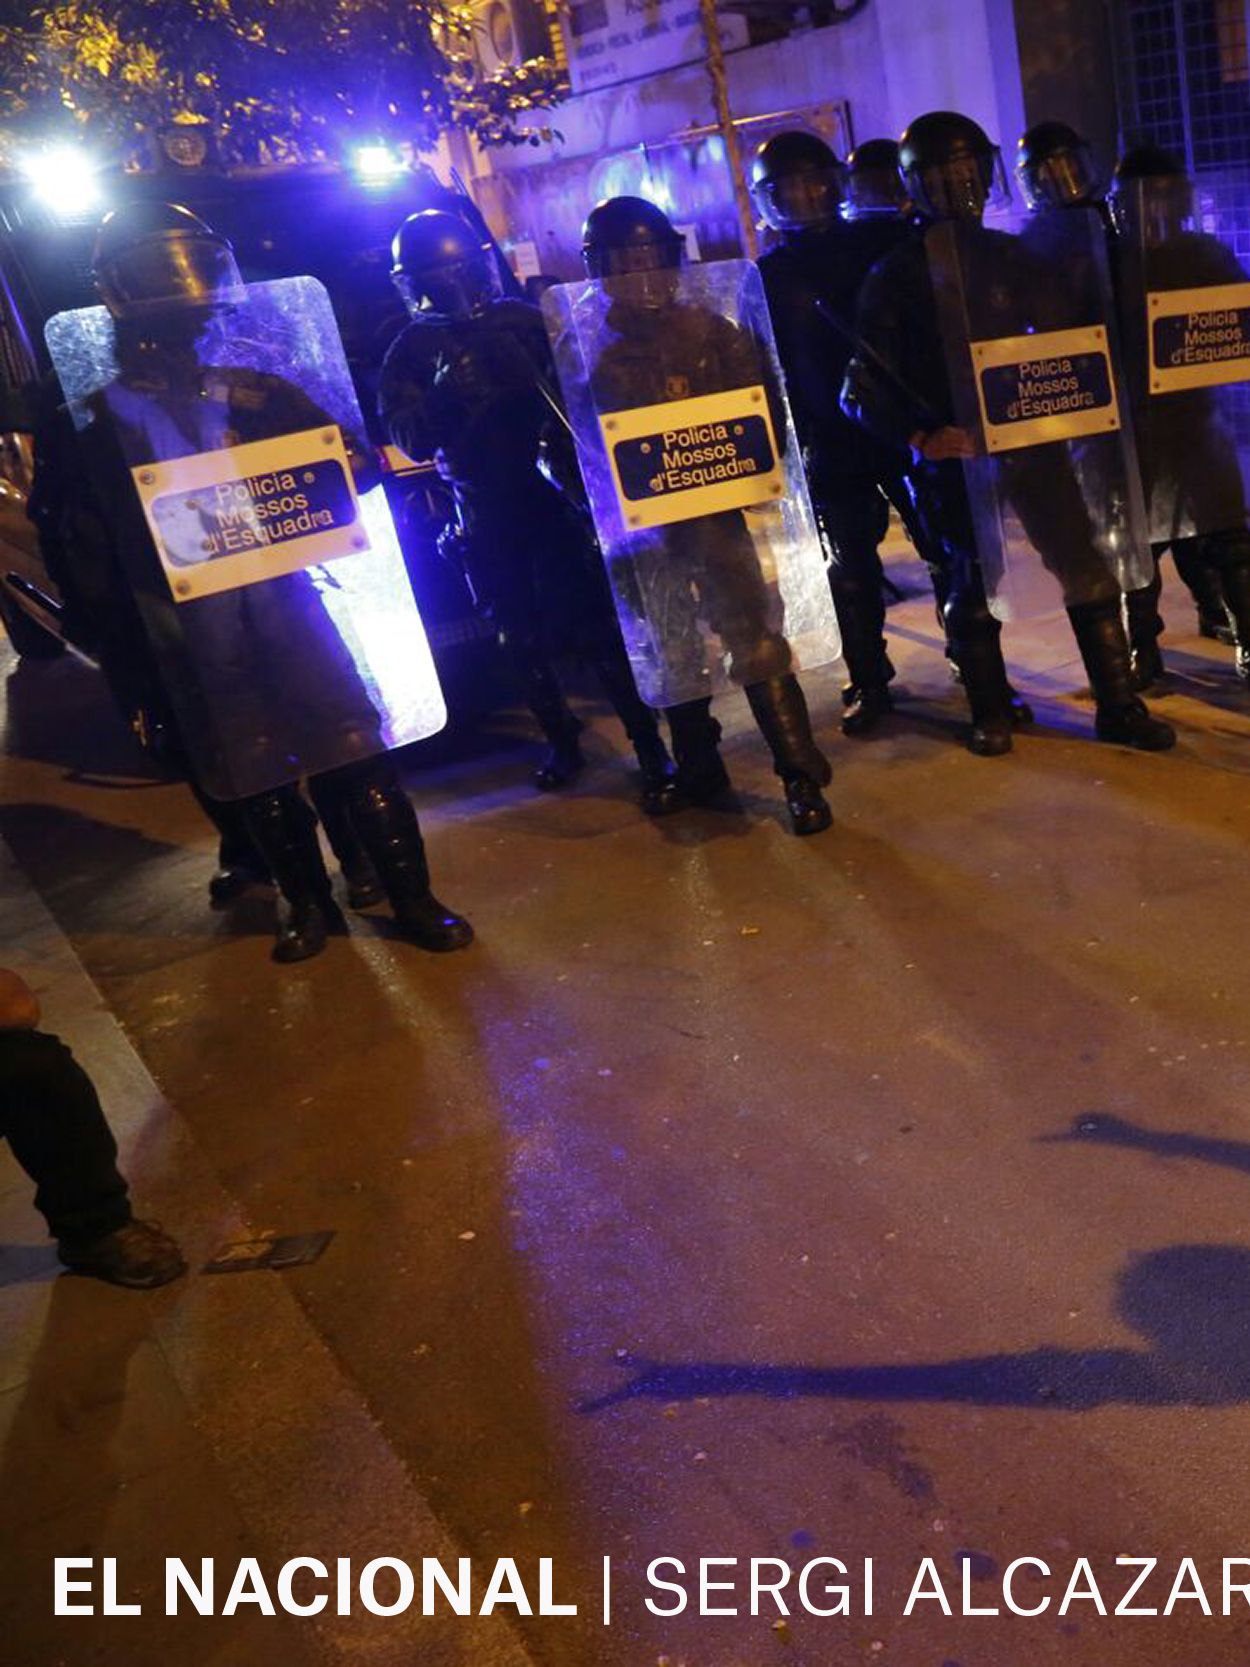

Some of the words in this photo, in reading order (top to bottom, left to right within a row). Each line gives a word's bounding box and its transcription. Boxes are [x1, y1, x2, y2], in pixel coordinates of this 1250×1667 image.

[1187, 311, 1238, 330] Policia
[1184, 327, 1243, 346] Mossos
[1018, 358, 1072, 380] Policia
[1017, 376, 1079, 398] Mossos
[1006, 390, 1095, 419] d'Esquadra
[662, 424, 729, 450] Policia
[661, 442, 737, 470] Mossos
[649, 457, 757, 492] d'Esquadra
[215, 472, 297, 506] Policia
[214, 493, 309, 528] Mossos
